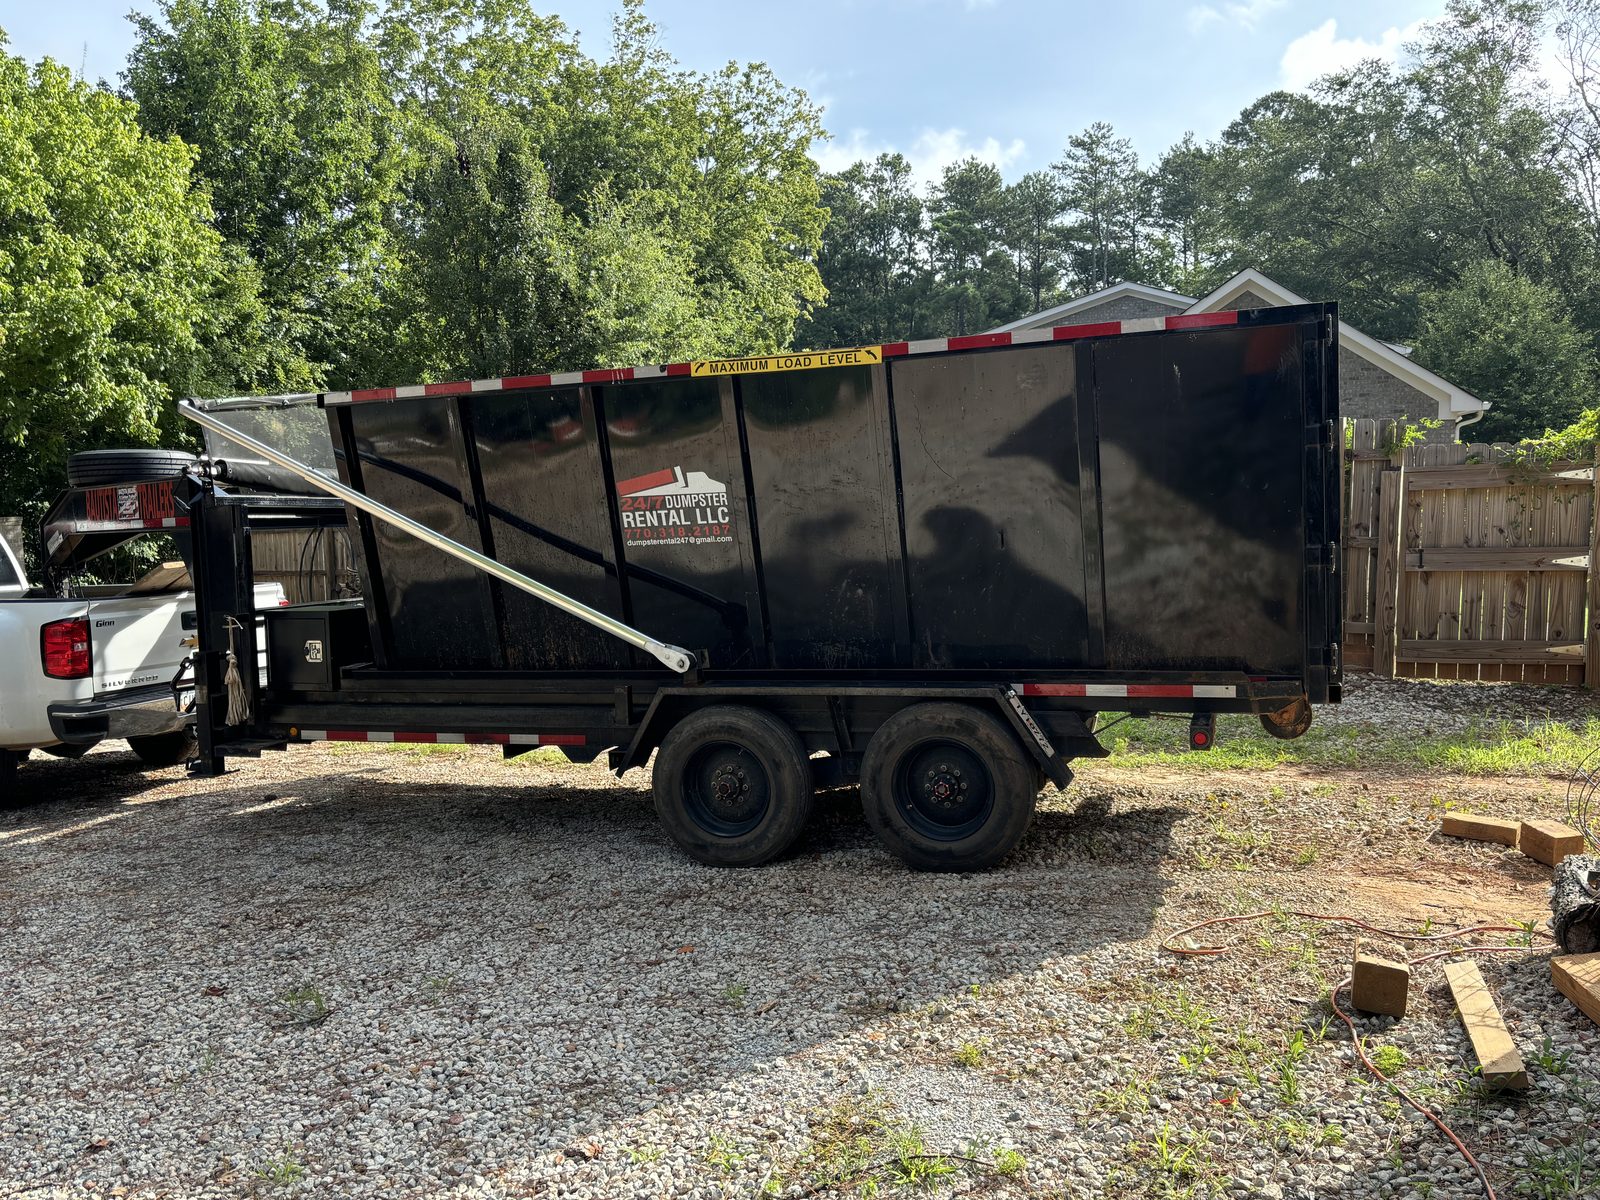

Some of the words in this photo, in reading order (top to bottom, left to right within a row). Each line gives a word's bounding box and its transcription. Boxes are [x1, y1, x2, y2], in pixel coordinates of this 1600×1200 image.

[709, 360, 769, 374] MAXIMUM
[776, 357, 812, 369] LOAD
[820, 353, 861, 366] LEVEL
[86, 488, 118, 520] BAUTISTA
[138, 481, 174, 519] TRAILERS
[621, 496, 665, 511] 24/7
[665, 492, 728, 509] DUMPSTER
[622, 509, 691, 528] RENTAL
[696, 506, 730, 525] LLC
[624, 525, 730, 539] 770.318.2187
